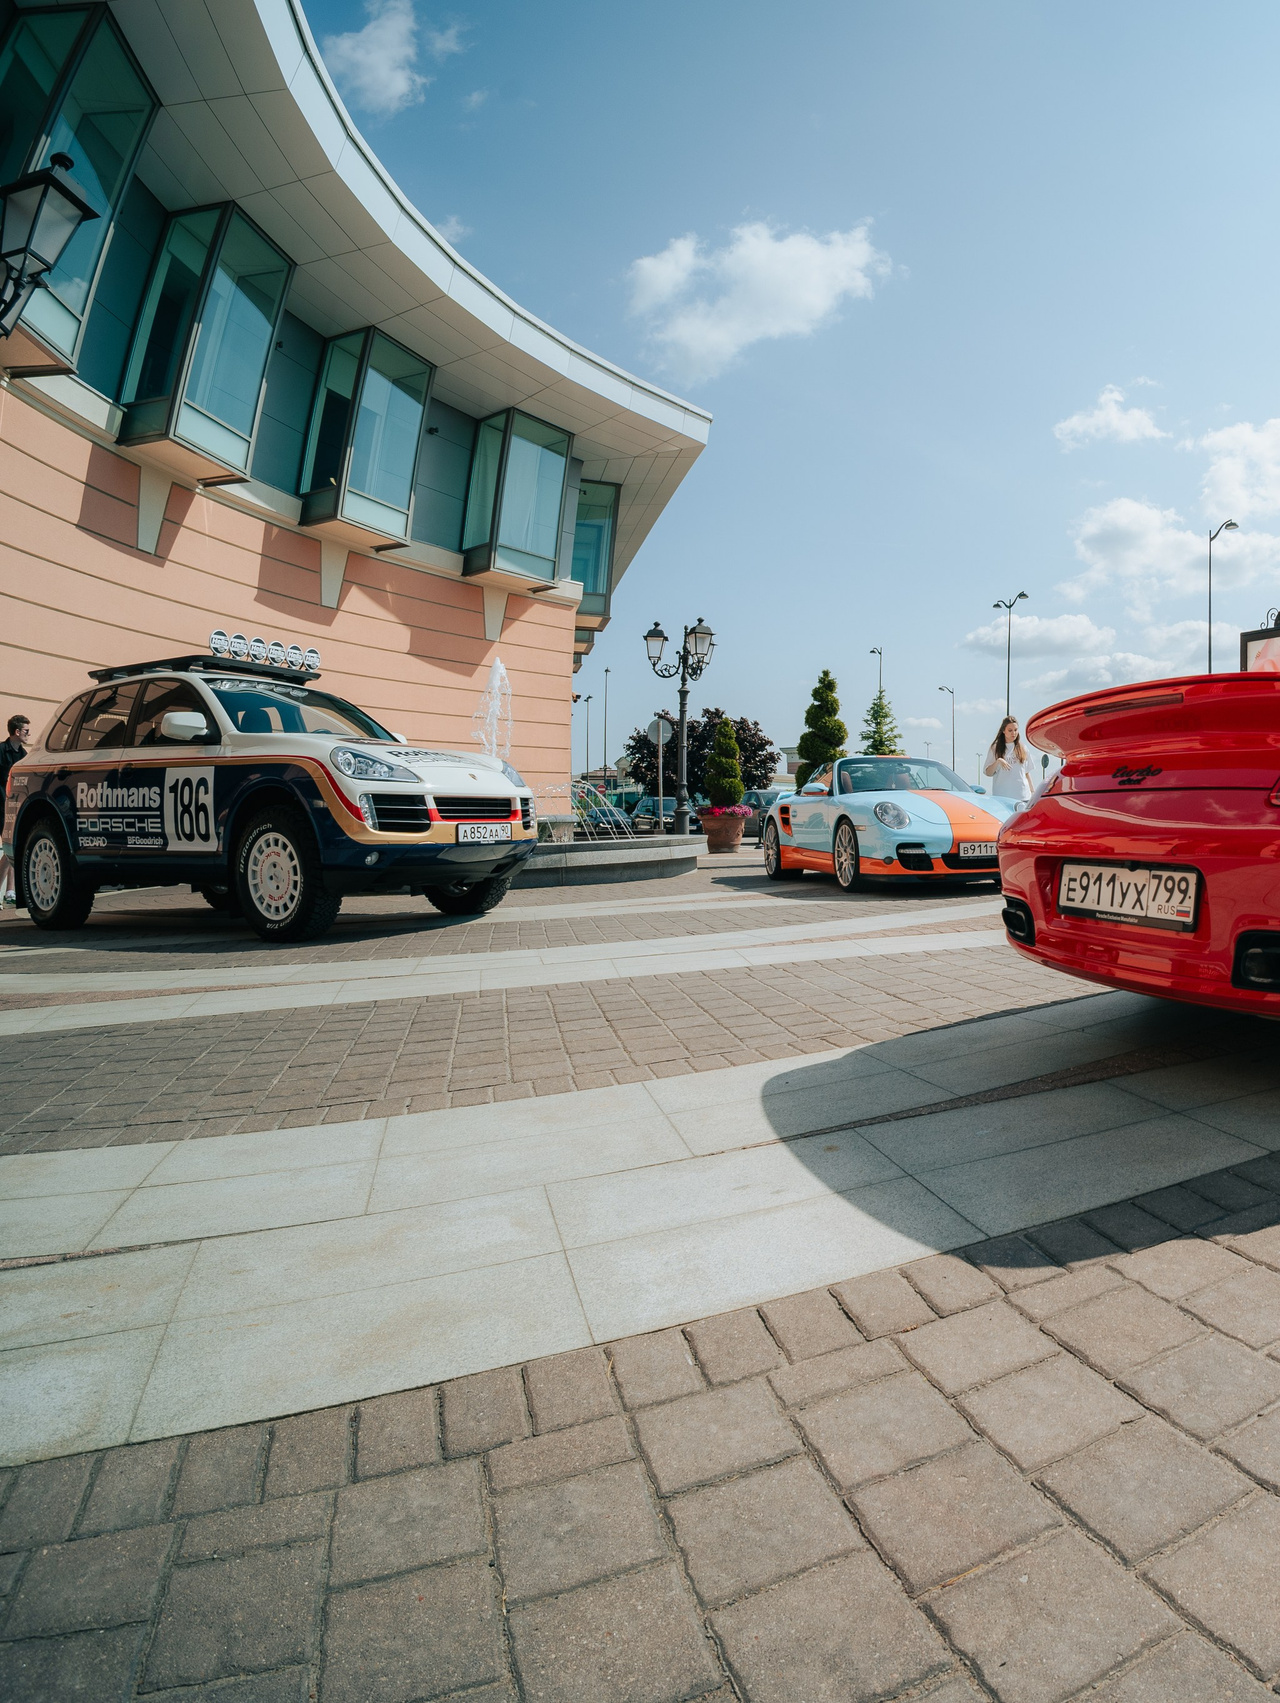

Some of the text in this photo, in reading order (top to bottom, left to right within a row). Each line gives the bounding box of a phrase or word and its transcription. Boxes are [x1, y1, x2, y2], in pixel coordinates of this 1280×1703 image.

[1111, 764, 1163, 779] turbo
[76, 781, 161, 809] Rothmans
[168, 776, 211, 843] 186
[76, 818, 162, 832] PORSCHE
[127, 836, 164, 845] BFGoodrich
[239, 823, 273, 873] BFGoodrich
[1066, 871, 1190, 911] Е911УХ 799
[1157, 904, 1175, 915] RUS
